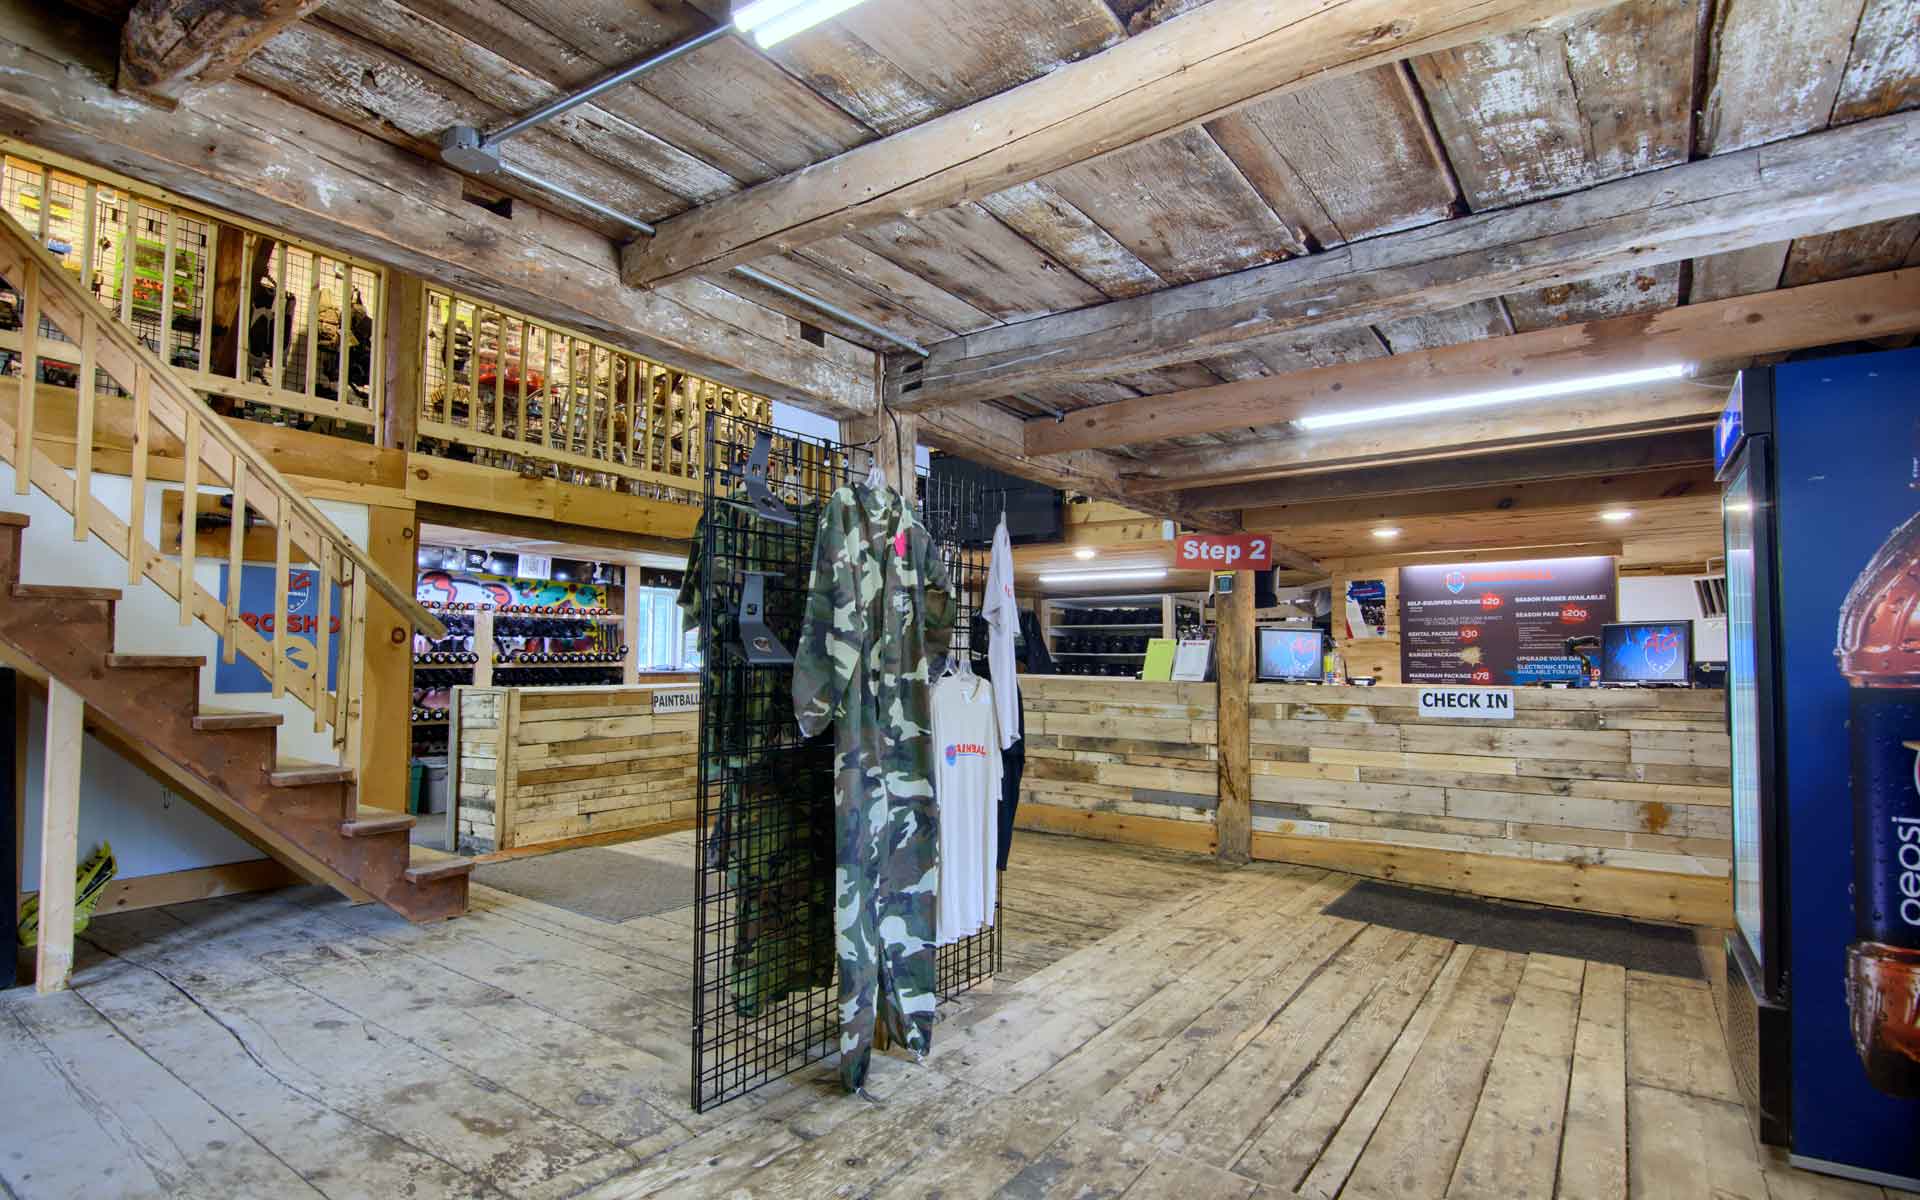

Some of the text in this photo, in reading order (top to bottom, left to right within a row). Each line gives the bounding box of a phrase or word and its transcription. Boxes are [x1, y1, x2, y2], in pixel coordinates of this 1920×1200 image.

[1183, 540, 1265, 564] Step 2
[653, 693, 700, 707] PAINTBALL
[1422, 692, 1508, 708] CHECK IN
